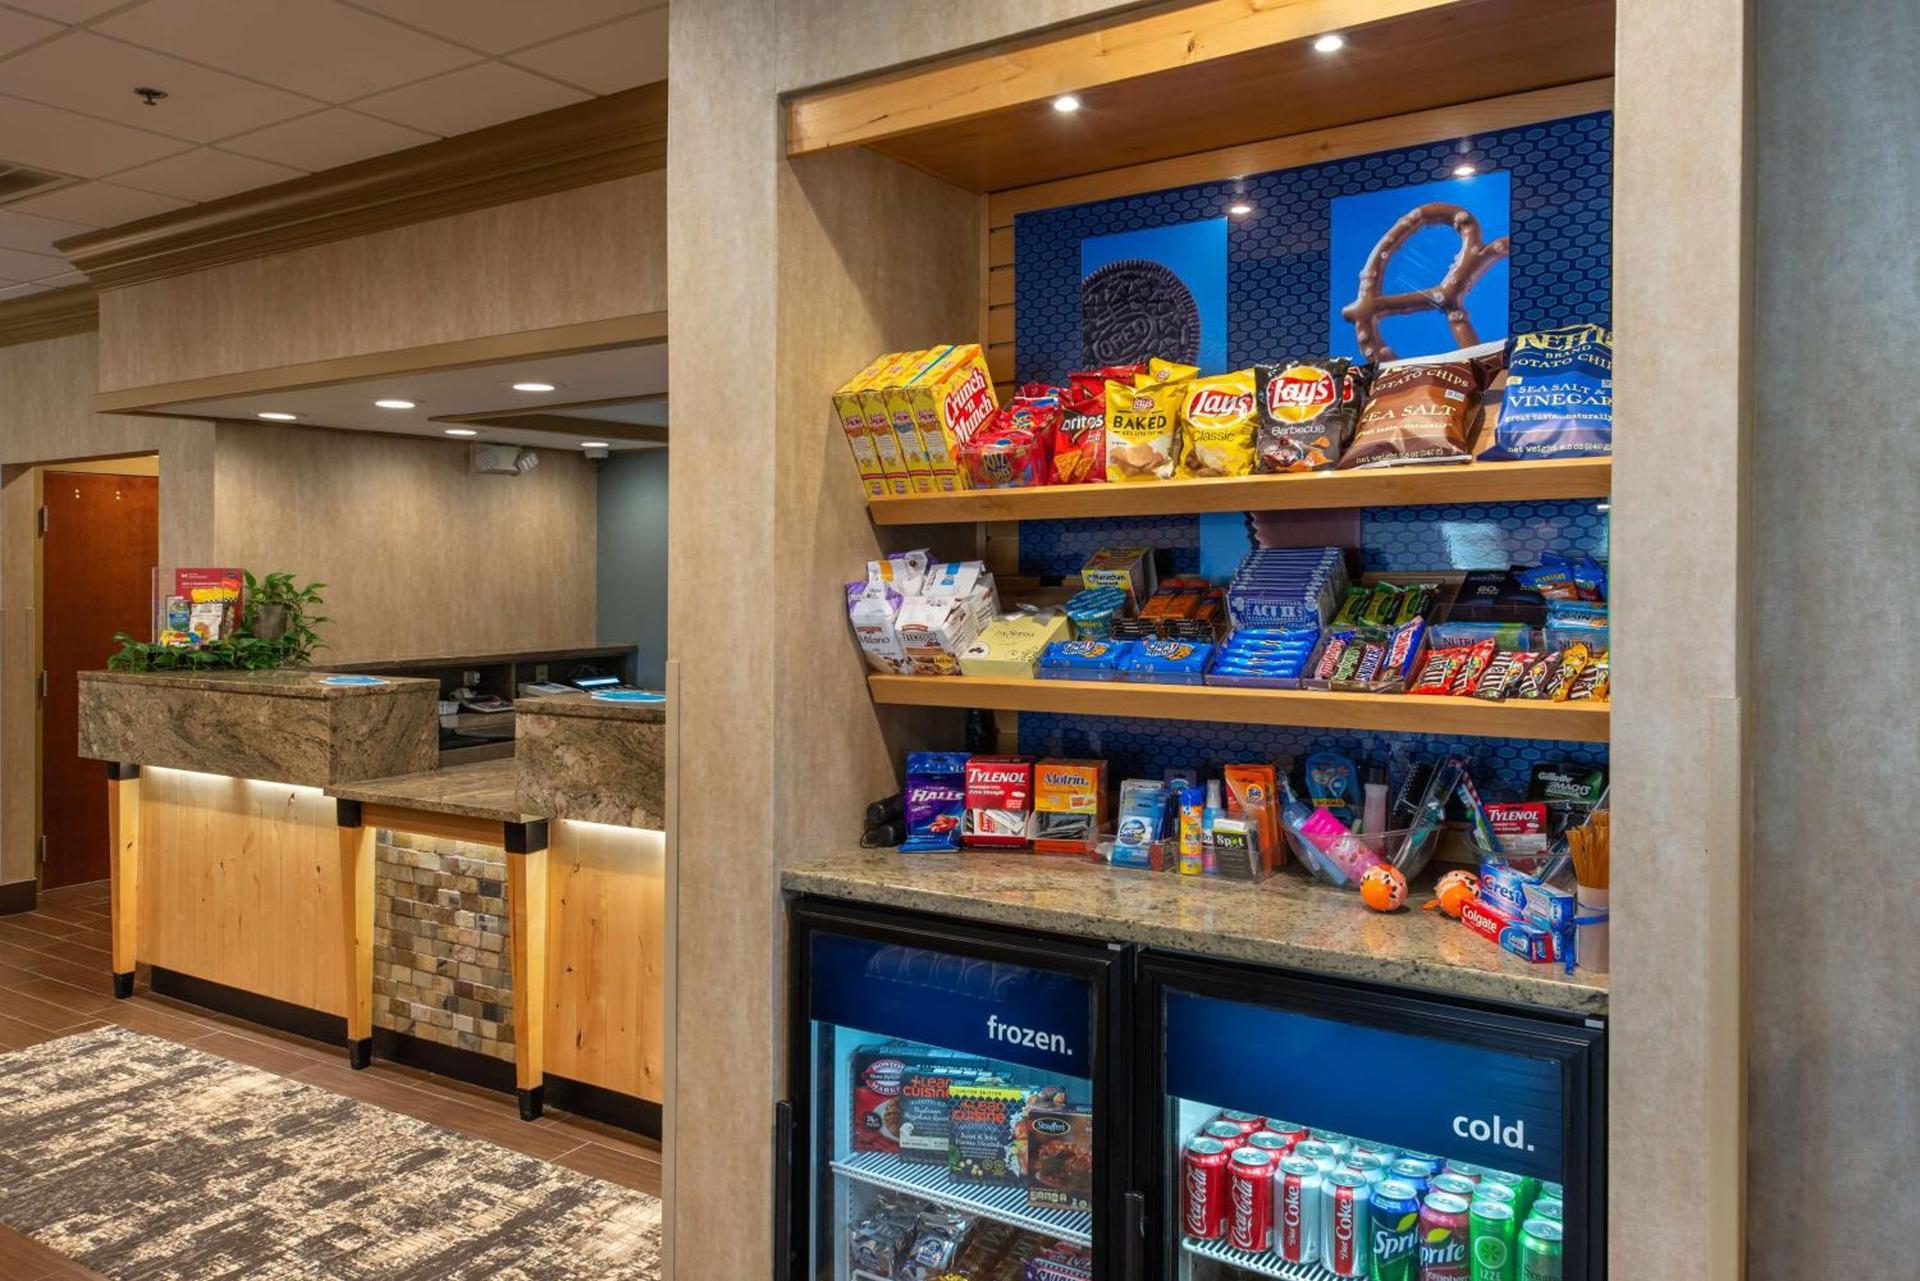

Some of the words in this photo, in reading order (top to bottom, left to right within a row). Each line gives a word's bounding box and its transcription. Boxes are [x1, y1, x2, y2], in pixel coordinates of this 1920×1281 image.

[1427, 368, 1469, 388] CHIPS
[1519, 384, 1548, 394] SEA
[1552, 383, 1590, 394] SALT
[945, 366, 986, 429] Crunch
[955, 394, 994, 444] Munch
[1402, 404, 1457, 417] SALT
[1113, 415, 1167, 429] BAKED
[1271, 424, 1326, 436] Barbecue
[1193, 430, 1235, 442] Classic
[1253, 605, 1277, 617] ACT
[1280, 606, 1297, 617] II
[969, 768, 1025, 783] TYLENOL
[911, 789, 964, 802] HALLS
[1489, 809, 1539, 821] TYLENOL
[1484, 875, 1521, 905] Crest
[1462, 905, 1497, 934] Colgate
[987, 1014, 1073, 1056] frozen.
[902, 1086, 951, 1099] cuisin
[1453, 1115, 1535, 1152] cold.
[1284, 1186, 1300, 1227] Coke
[1336, 1198, 1353, 1240] Coke
[1420, 1240, 1465, 1267] prite
